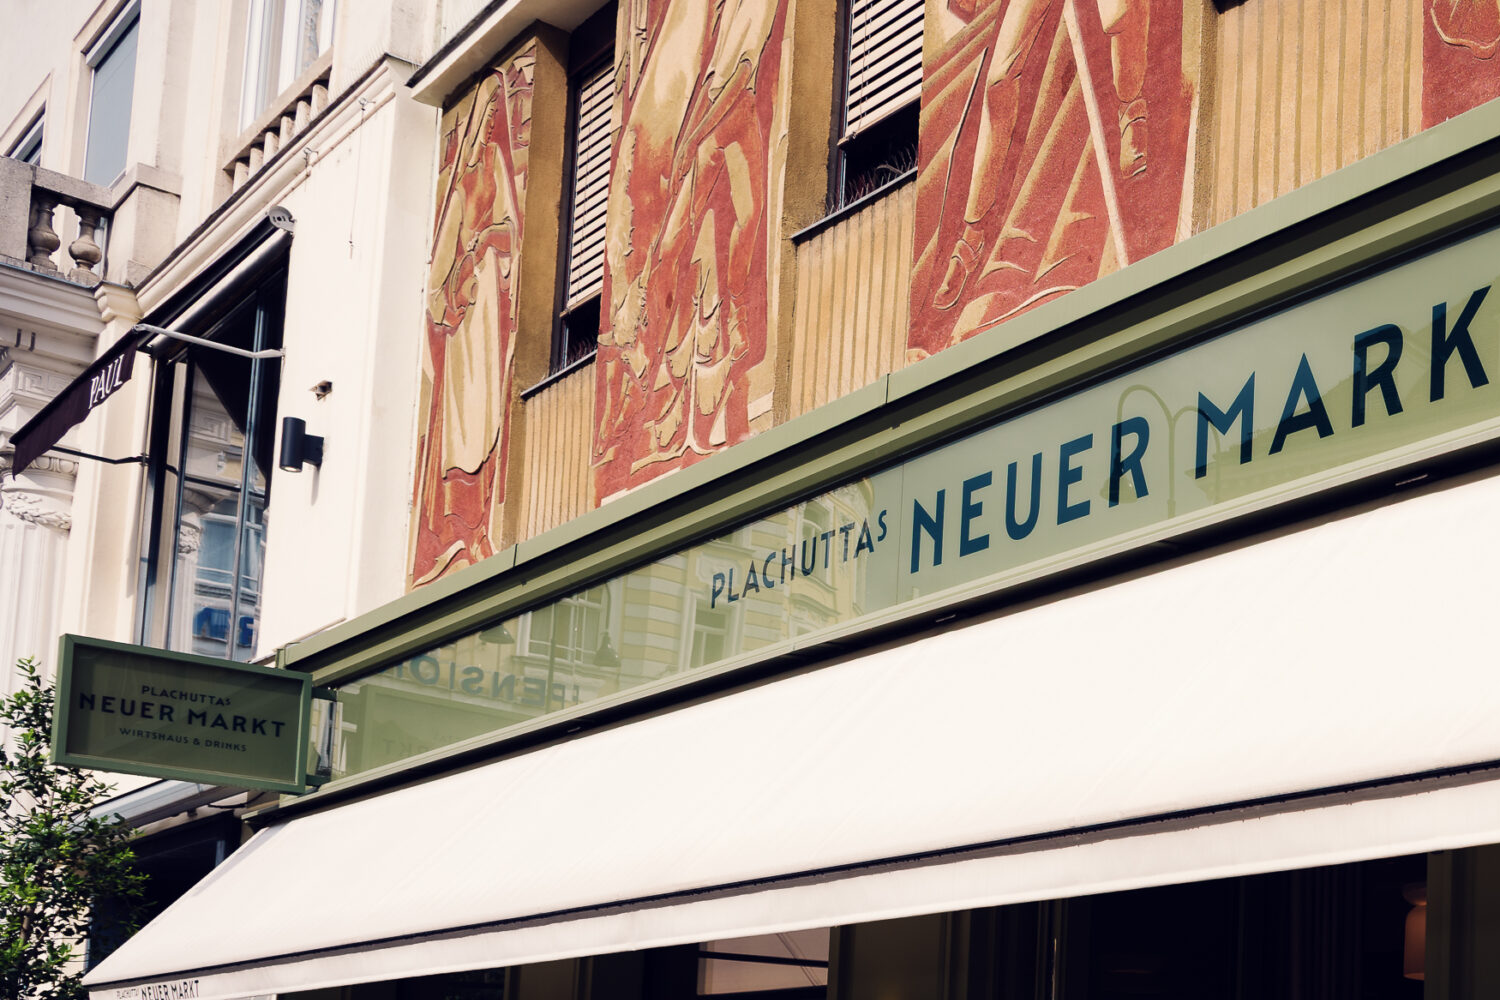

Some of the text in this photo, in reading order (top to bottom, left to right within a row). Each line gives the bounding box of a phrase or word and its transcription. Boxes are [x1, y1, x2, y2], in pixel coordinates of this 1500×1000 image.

[88, 354, 125, 409] PAUL
[710, 509, 888, 609] PLACHUTTAS
[910, 416, 1151, 574] NEUER
[141, 685, 231, 706] PLACHUTTAS
[79, 692, 286, 738] NEUER MARKT
[119, 727, 248, 752] WIRTSHAUS & DRINKS
[170, 980, 199, 1000] MARKT
